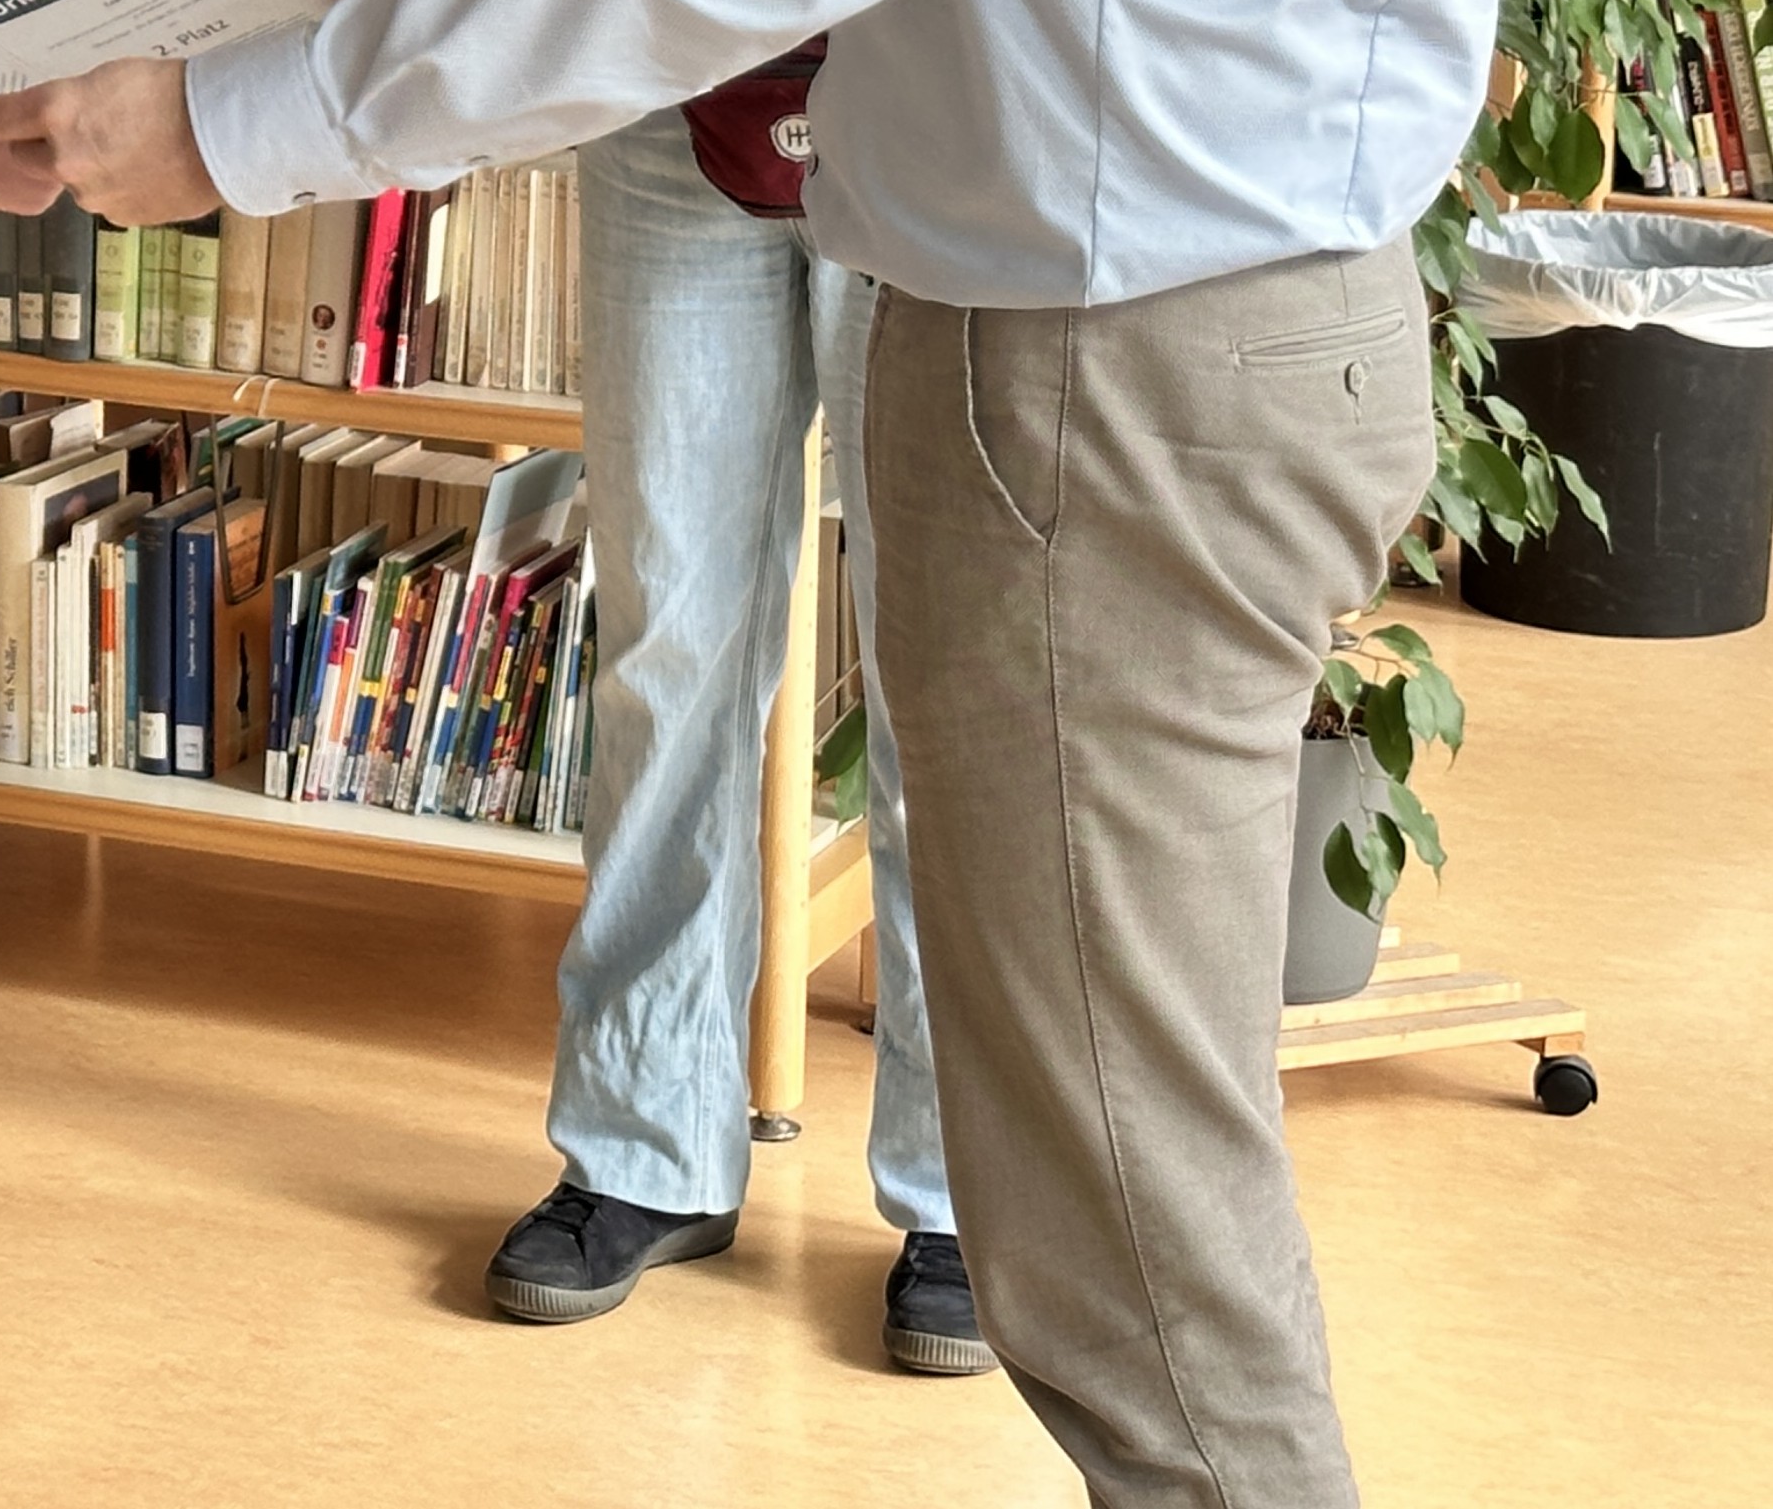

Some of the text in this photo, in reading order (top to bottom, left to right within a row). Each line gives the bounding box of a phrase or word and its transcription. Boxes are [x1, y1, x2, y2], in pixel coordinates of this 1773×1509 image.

[151, 18, 231, 57] 2. Platz
[4, 637, 17, 685] Schiller
